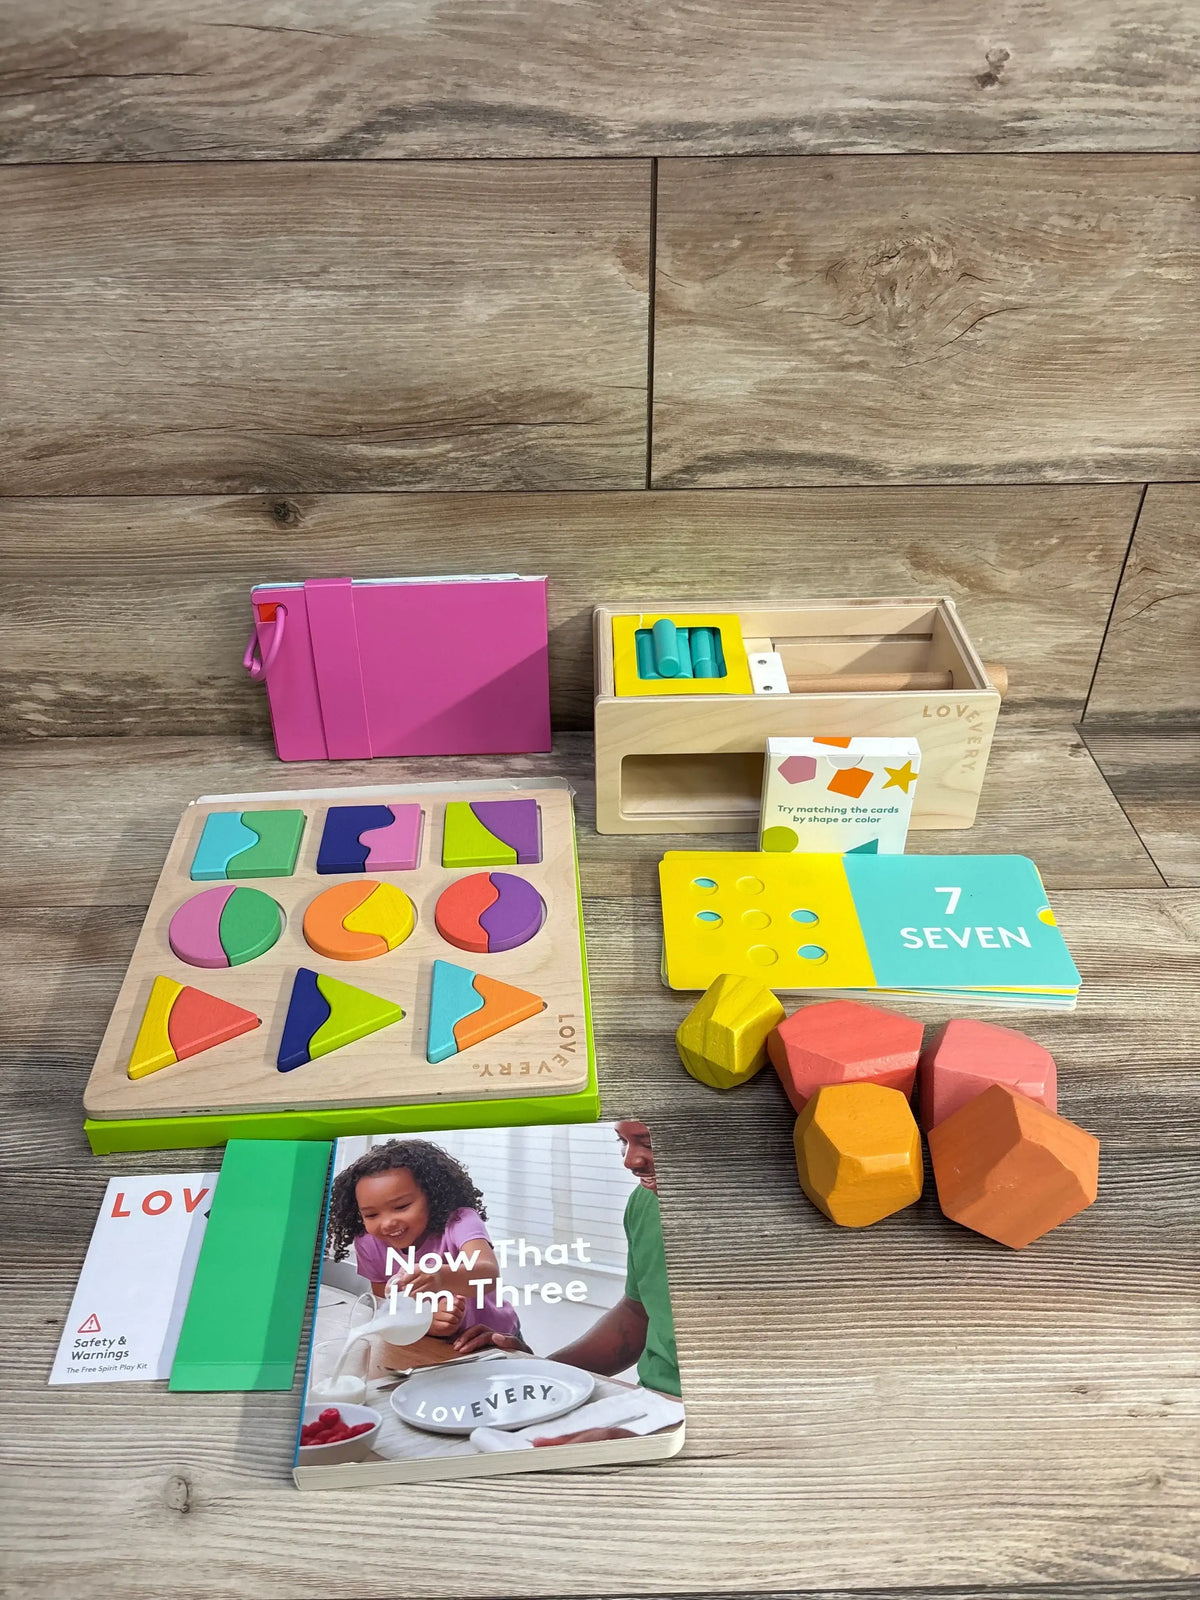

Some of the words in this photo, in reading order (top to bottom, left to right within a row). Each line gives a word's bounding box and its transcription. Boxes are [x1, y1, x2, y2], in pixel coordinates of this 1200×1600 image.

[778, 805, 794, 814] Try
[796, 805, 848, 815] matching
[850, 806, 868, 814] the
[870, 806, 900, 814] cards
[793, 815, 806, 824] by
[808, 815, 839, 824] shape
[934, 886, 962, 915] 7
[900, 926, 1032, 949] SEVEN
[110, 1187, 212, 1220] LOV
[384, 1245, 481, 1276] Now
[495, 1237, 591, 1267] That
[388, 1284, 454, 1316] I'm
[468, 1278, 588, 1310] Three
[73, 1337, 116, 1349] Safety
[118, 1335, 127, 1345] &
[71, 1349, 129, 1361] Warnings
[98, 1365, 118, 1373] Spirit
[415, 1384, 554, 1422] LOVEVERY
